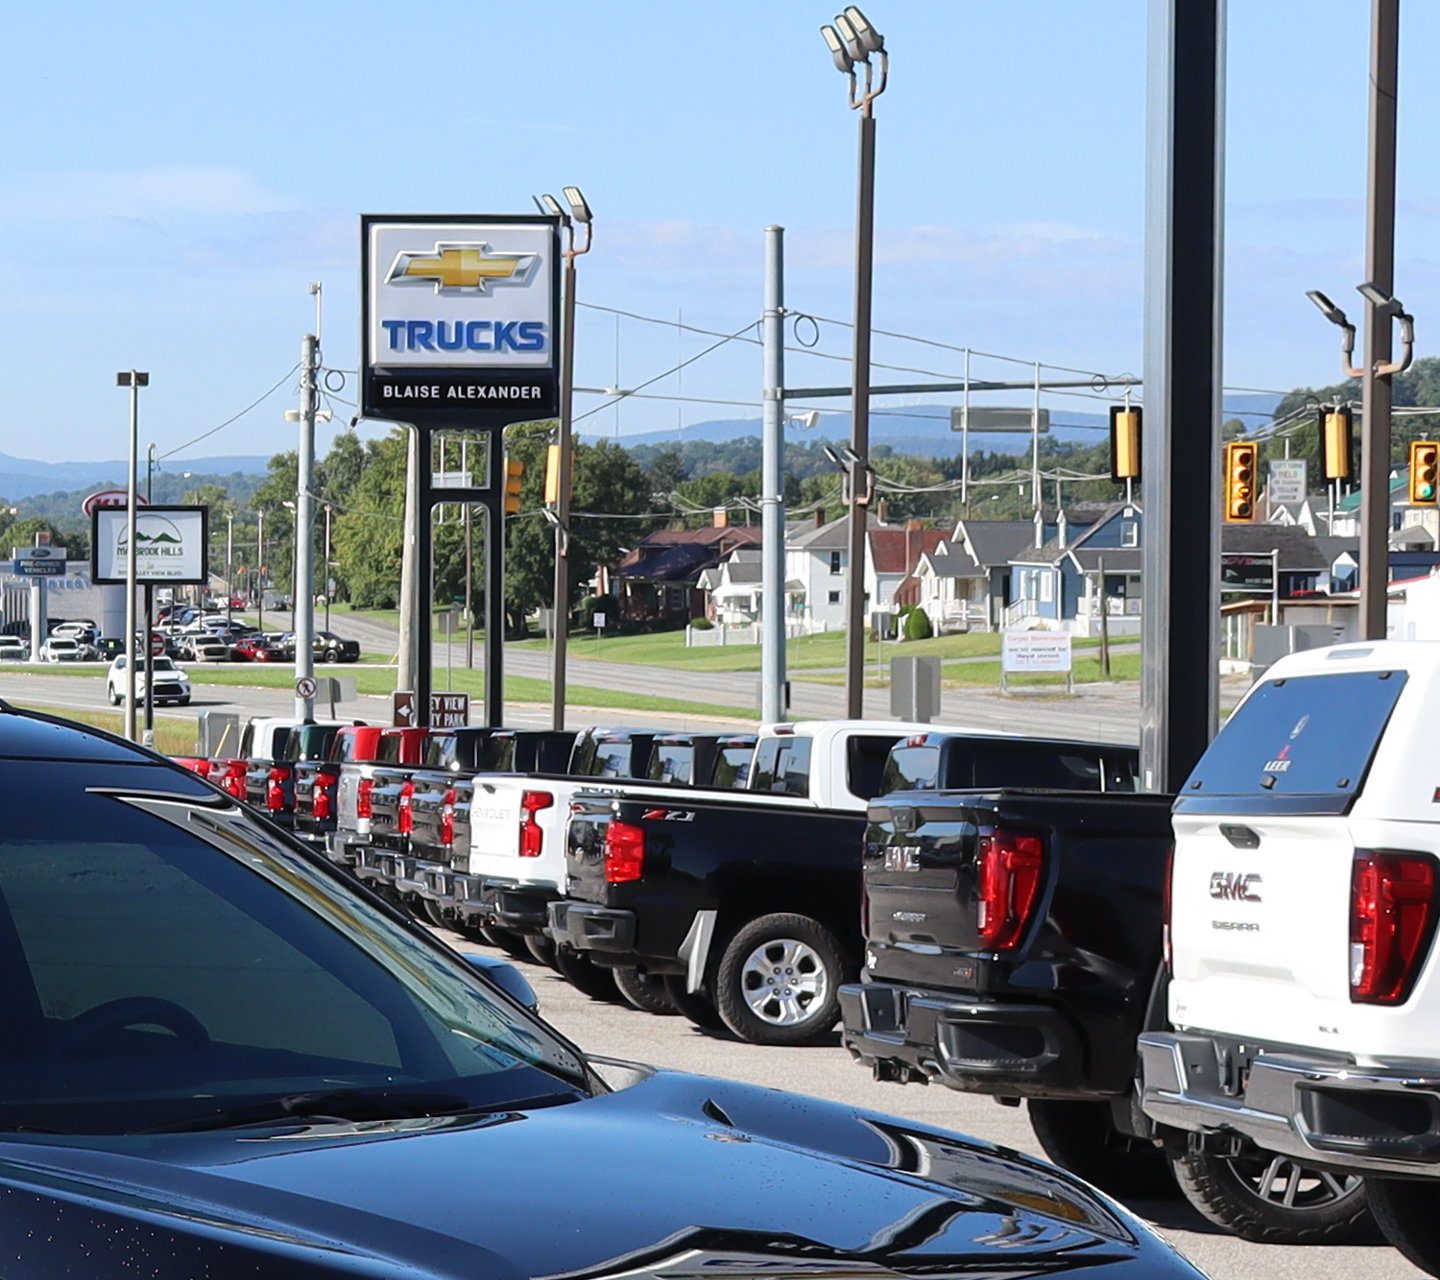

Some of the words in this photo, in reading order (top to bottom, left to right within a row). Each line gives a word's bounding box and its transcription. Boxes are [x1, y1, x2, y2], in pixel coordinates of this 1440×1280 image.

[381, 320, 545, 351] TRUCKS
[382, 385, 441, 399] BLAISE
[446, 385, 542, 400] ALEXANDER
[116, 547, 160, 557] MABROOK
[160, 547, 184, 557] HILLS
[443, 696, 466, 710] VIEW
[444, 712, 465, 727] PARK
[1263, 760, 1291, 772] LEER
[641, 808, 697, 822] Z71
[1209, 871, 1263, 903] GMC
[1211, 920, 1261, 933] SIERRA
